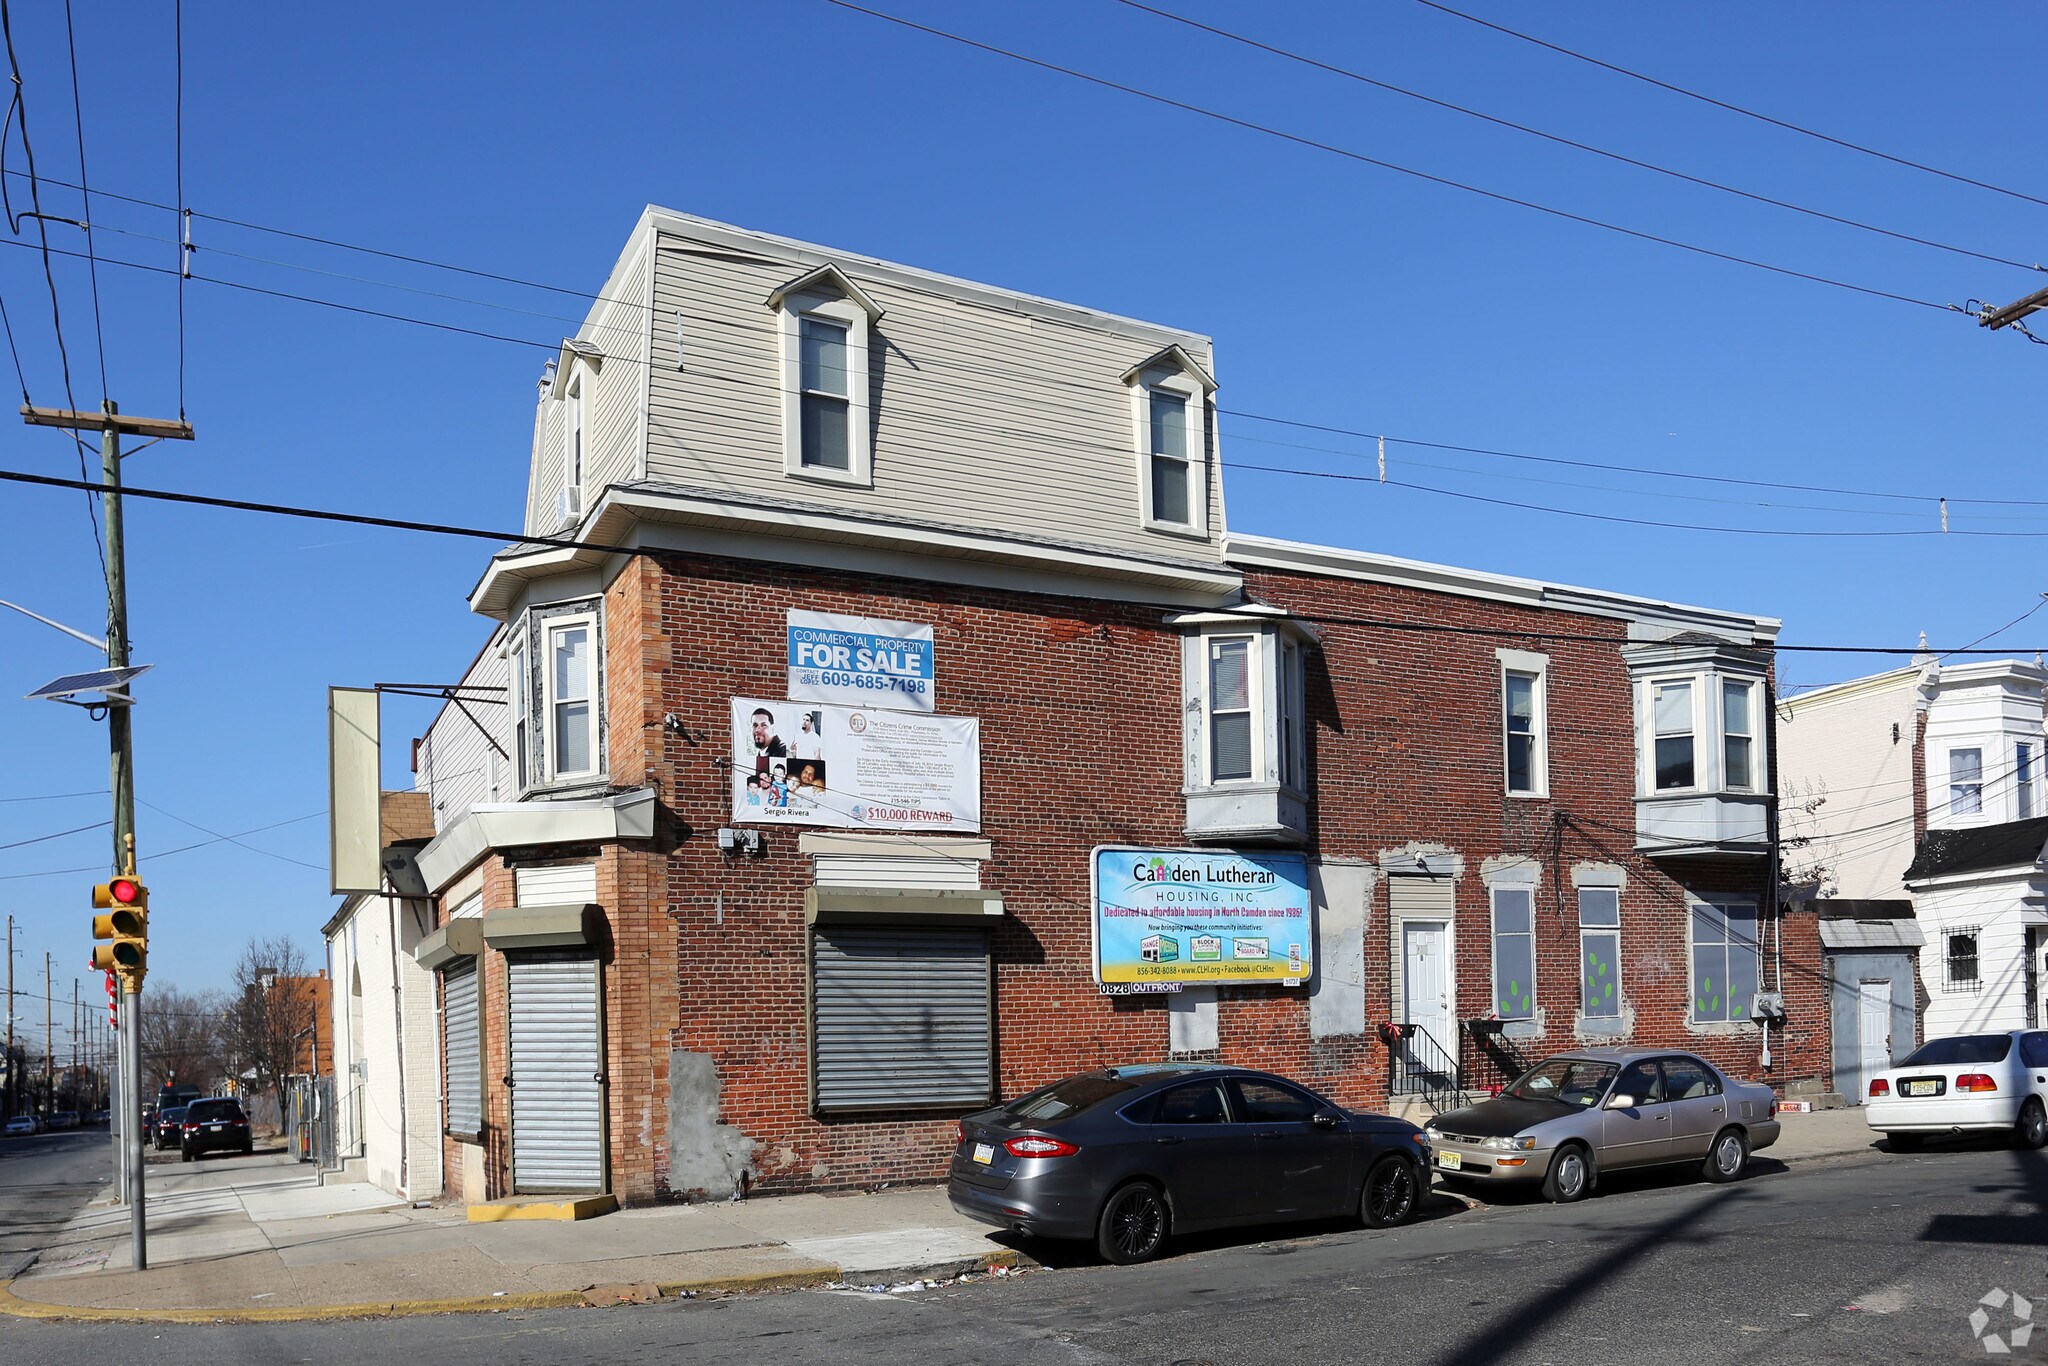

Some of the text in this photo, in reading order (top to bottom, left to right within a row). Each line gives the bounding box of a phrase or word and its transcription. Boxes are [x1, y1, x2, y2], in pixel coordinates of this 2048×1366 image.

[794, 629, 925, 653] COMMERCIAL PROPERTY
[798, 643, 921, 676] FOR SALE
[821, 671, 925, 693] 609-685-7198
[764, 807, 809, 818] Sergio Rivera
[868, 807, 952, 822] $10,000 REWARD
[1207, 865, 1275, 883] Lutheran
[1157, 892, 1258, 902] HOUSING, INC.
[1104, 907, 1139, 917] Dedicated
[1141, 908, 1147, 916] to
[1150, 907, 1184, 917] affordable
[1186, 907, 1212, 918] housing
[1214, 907, 1220, 917] in
[1222, 907, 1239, 917] North
[1241, 907, 1266, 917] Camden
[1268, 908, 1284, 917] since
[1161, 924, 1183, 932] bringing
[1137, 967, 1177, 975] 856-342-8088
[1182, 966, 1220, 975] www.CLHI.org
[1224, 965, 1250, 973] Facebook
[1101, 984, 1180, 994] 0828 OUTFRONT
